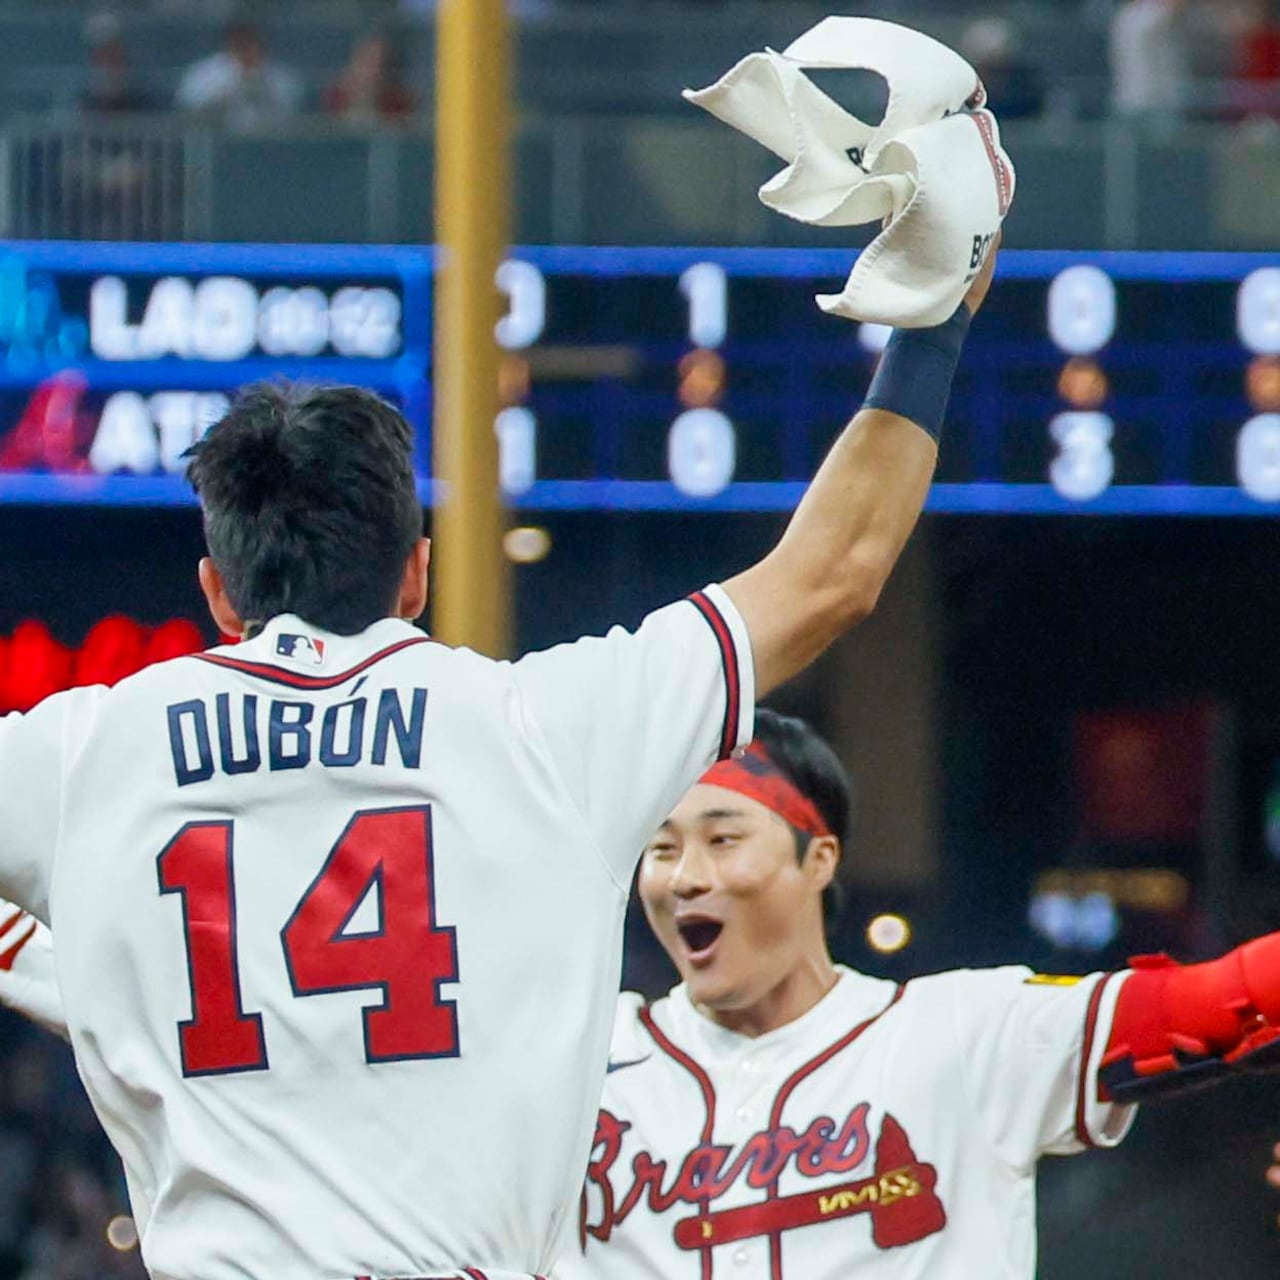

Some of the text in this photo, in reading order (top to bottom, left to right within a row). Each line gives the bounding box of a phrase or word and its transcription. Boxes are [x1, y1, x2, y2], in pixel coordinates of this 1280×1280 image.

[682, 262, 727, 347] 1
[1048, 265, 1116, 354] 0
[494, 406, 536, 494] 1
[668, 407, 736, 497] 0
[1049, 410, 1115, 498] 3
[167, 676, 428, 787] DUBÓN
[156, 803, 461, 1079] 14
[579, 1101, 871, 1256] Braves
